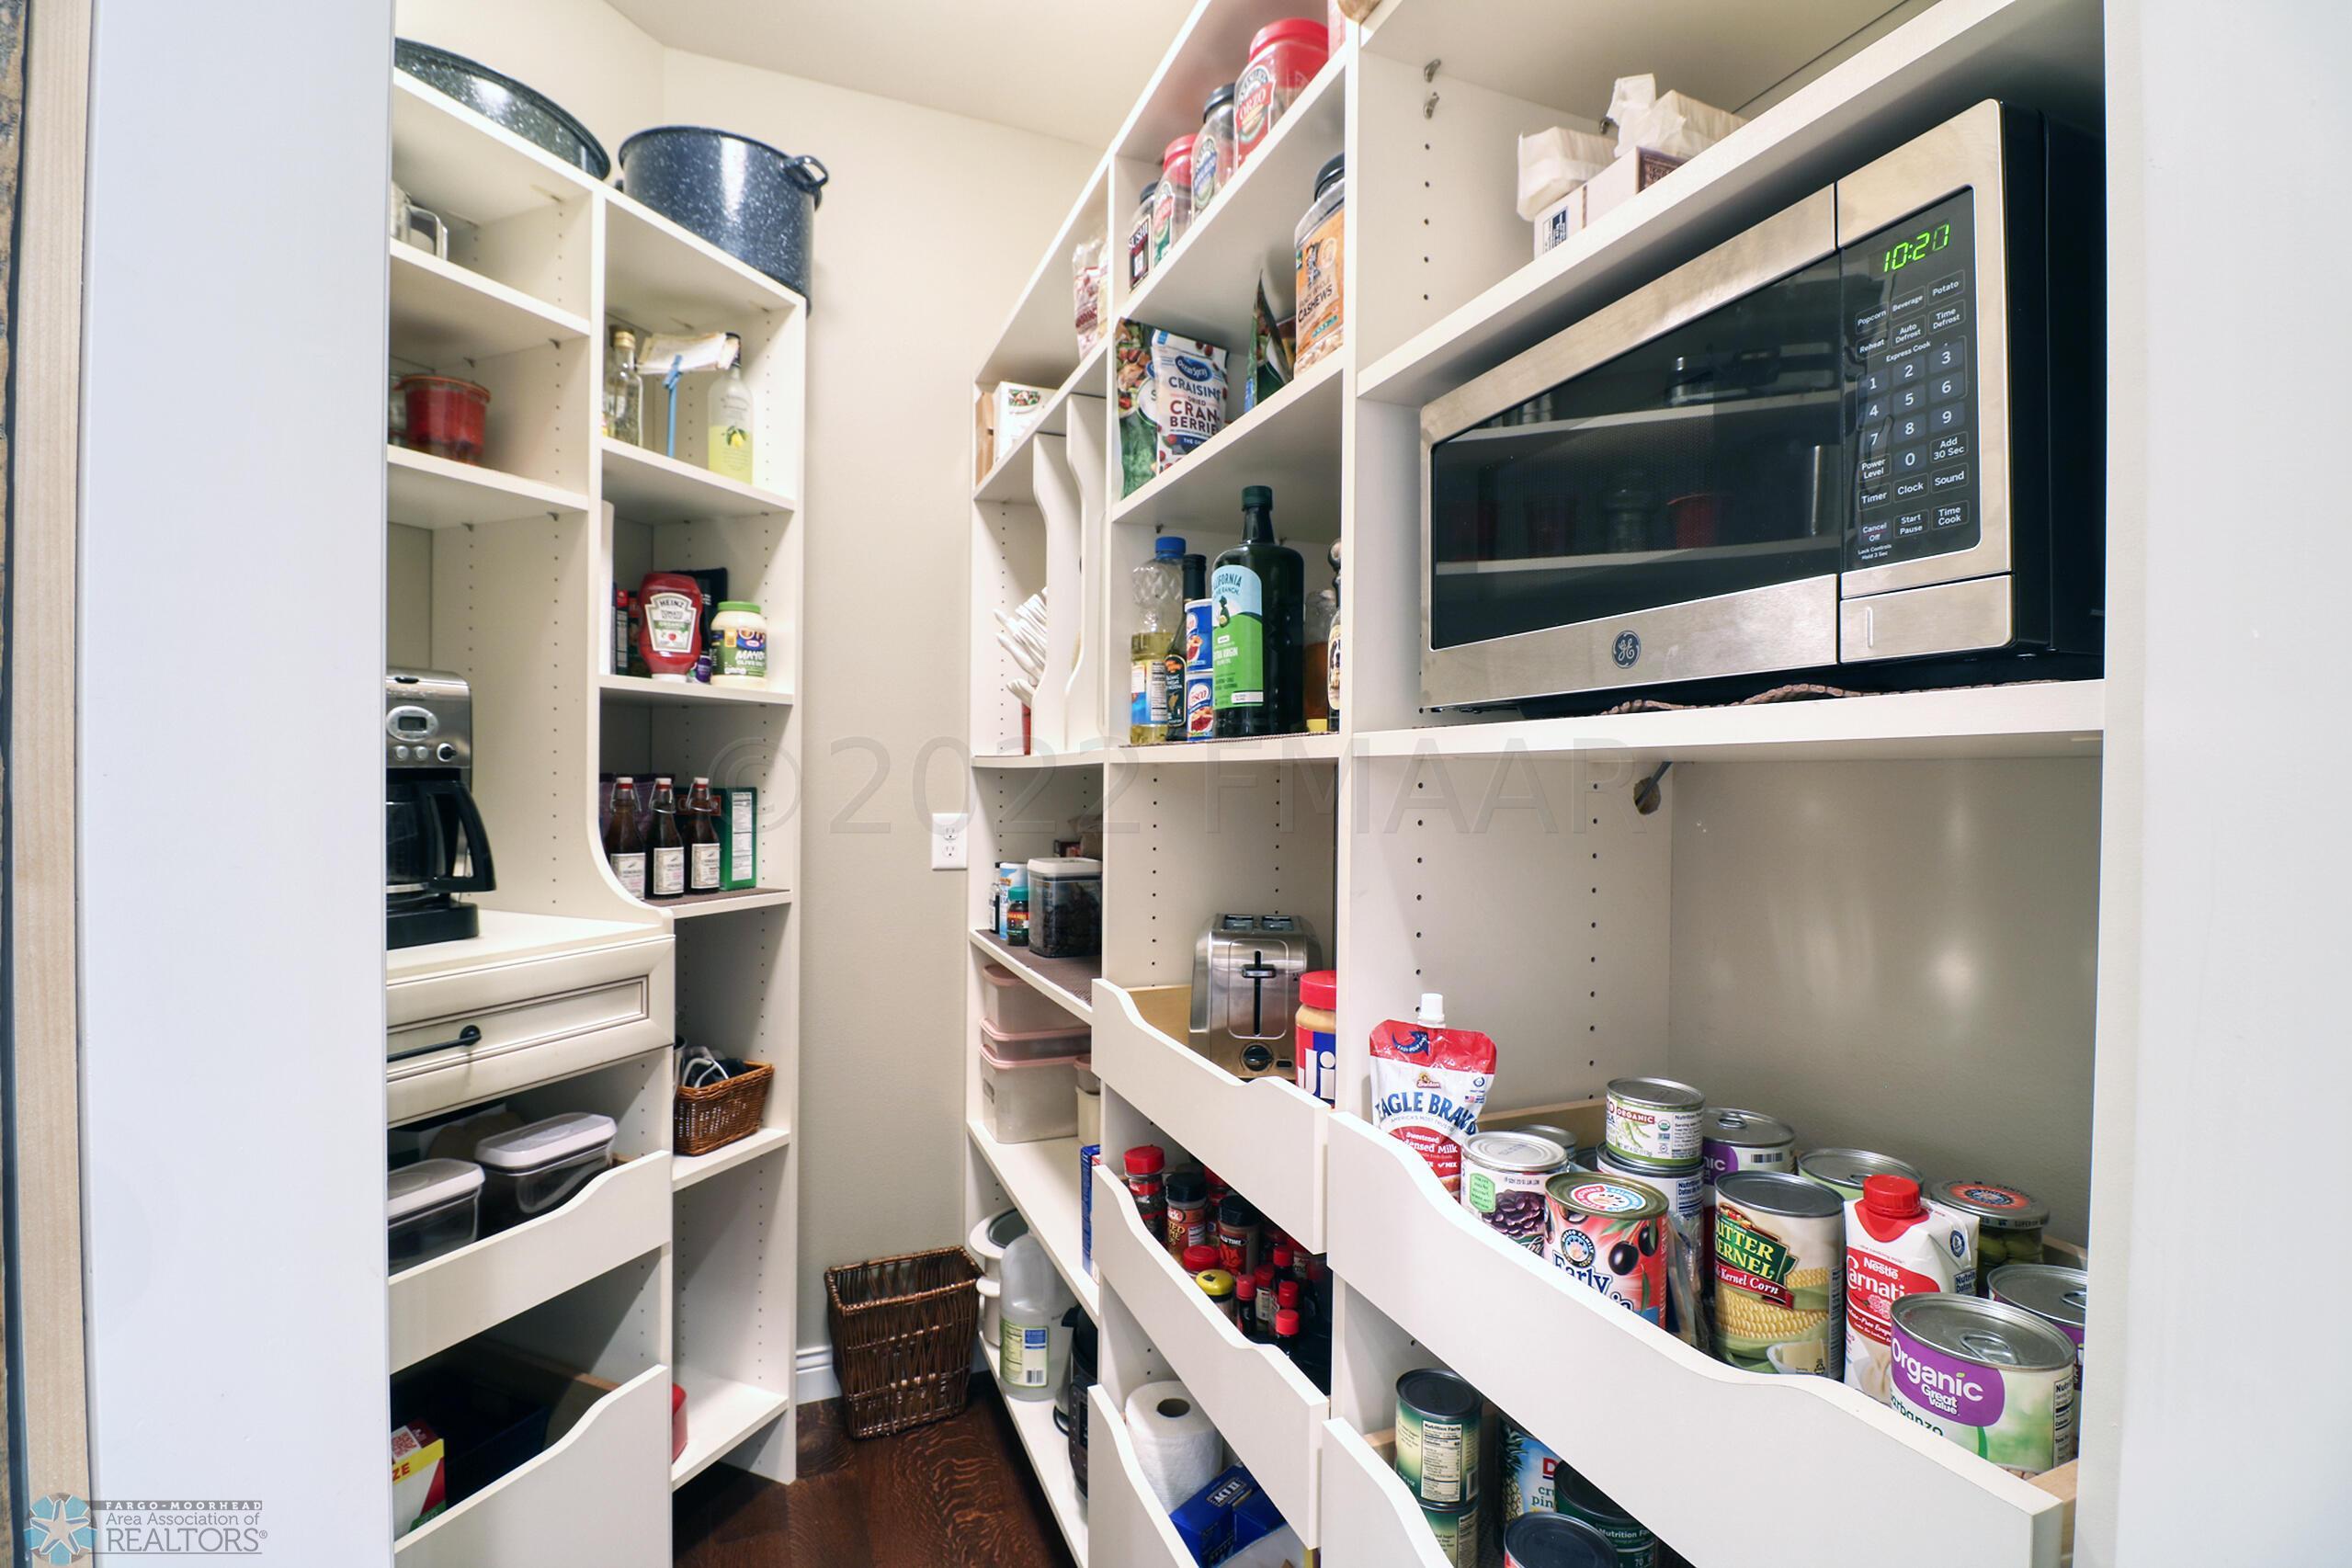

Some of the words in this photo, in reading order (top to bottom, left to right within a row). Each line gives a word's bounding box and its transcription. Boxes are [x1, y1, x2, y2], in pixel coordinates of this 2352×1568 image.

[1932, 280, 1960, 296] Potato
[1298, 284, 1333, 323] CASHEWS
[1892, 295, 1924, 312] Beverage
[1857, 310, 1887, 326] Popcorn
[1932, 314, 1960, 329] Defrost
[1936, 309, 1957, 321] Time
[1895, 329, 1922, 344] Defrost
[1899, 324, 1918, 335] Auto
[1859, 338, 1885, 353] Reheat
[1885, 347, 1913, 362] Express
[1913, 341, 1931, 353] Cook
[1941, 351, 1951, 365] 3
[1903, 364, 1914, 378] 2
[1168, 376, 1221, 403] CRAISINS
[1869, 377, 1877, 390] 1
[1941, 381, 1951, 393] 6
[1904, 392, 1915, 405] 5
[1869, 404, 1879, 416] 4
[1942, 410, 1952, 424] 9
[1170, 416, 1218, 436] BERRIE
[1904, 422, 1915, 435] 8
[1870, 433, 1879, 446] 7
[1939, 437, 1958, 449] Add
[1904, 452, 1915, 466] 0
[1933, 449, 1946, 461] 30
[1948, 446, 1965, 457] Sec
[1861, 458, 1886, 471] Power
[1863, 467, 1884, 480] Level
[1934, 471, 1965, 486] Sound
[1897, 482, 1925, 495] Clock
[1861, 492, 1888, 505] Timer
[1938, 506, 1961, 517] Time
[1901, 514, 1921, 524] Start
[1937, 515, 1961, 526] Cook
[1862, 522, 1887, 534] Cancel
[1899, 525, 1923, 535] Pause
[1869, 534, 1880, 542] Off
[659, 598, 685, 608] HEINZ
[735, 650, 766, 661] MAYO
[1298, 1048, 1335, 1099] Ji
[1616, 1107, 1654, 1123] ORGANIC
[1406, 1131, 1440, 1144] Sweetened
[1437, 1143, 1458, 1155] Milk
[1716, 1221, 1775, 1263] UTTER
[1718, 1240, 1773, 1279] ERNEL
[1720, 1267, 1747, 1287] Kernel
[1749, 1278, 1779, 1295] Corn
[1846, 1255, 1907, 1300] Carnati
[1955, 1270, 1977, 1285] Nutri
[1892, 1336, 1984, 1402] Organic
[1920, 1384, 1959, 1408] Great
[1928, 1395, 1959, 1416] Value
[1891, 1391, 1945, 1437] arbanzo
[392, 1462, 411, 1482] ZE
[1214, 1488, 1232, 1503] ACT
[1598, 1528, 1638, 1539] Nutrition
